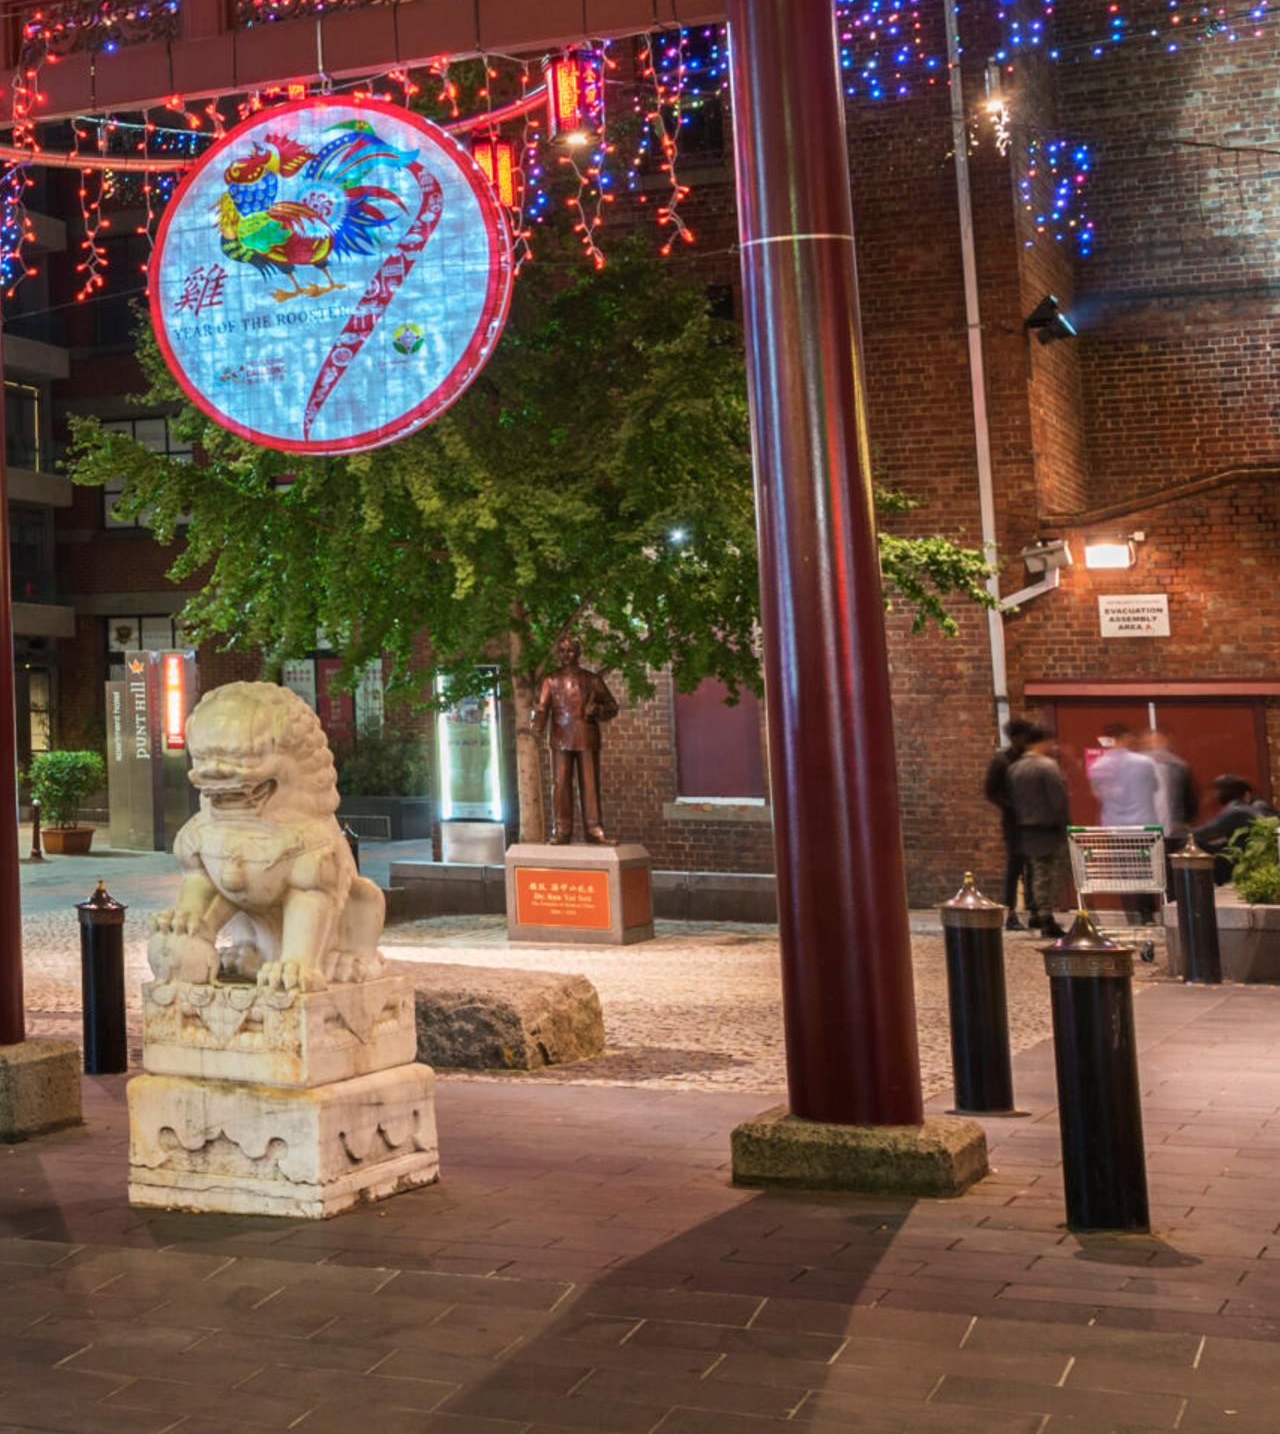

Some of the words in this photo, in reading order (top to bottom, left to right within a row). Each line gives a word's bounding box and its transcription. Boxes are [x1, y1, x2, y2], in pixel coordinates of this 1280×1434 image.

[173, 323, 215, 342] YEAR
[216, 320, 238, 336] OF
[239, 314, 272, 332] THE
[1104, 607, 1163, 615] EVACUATION
